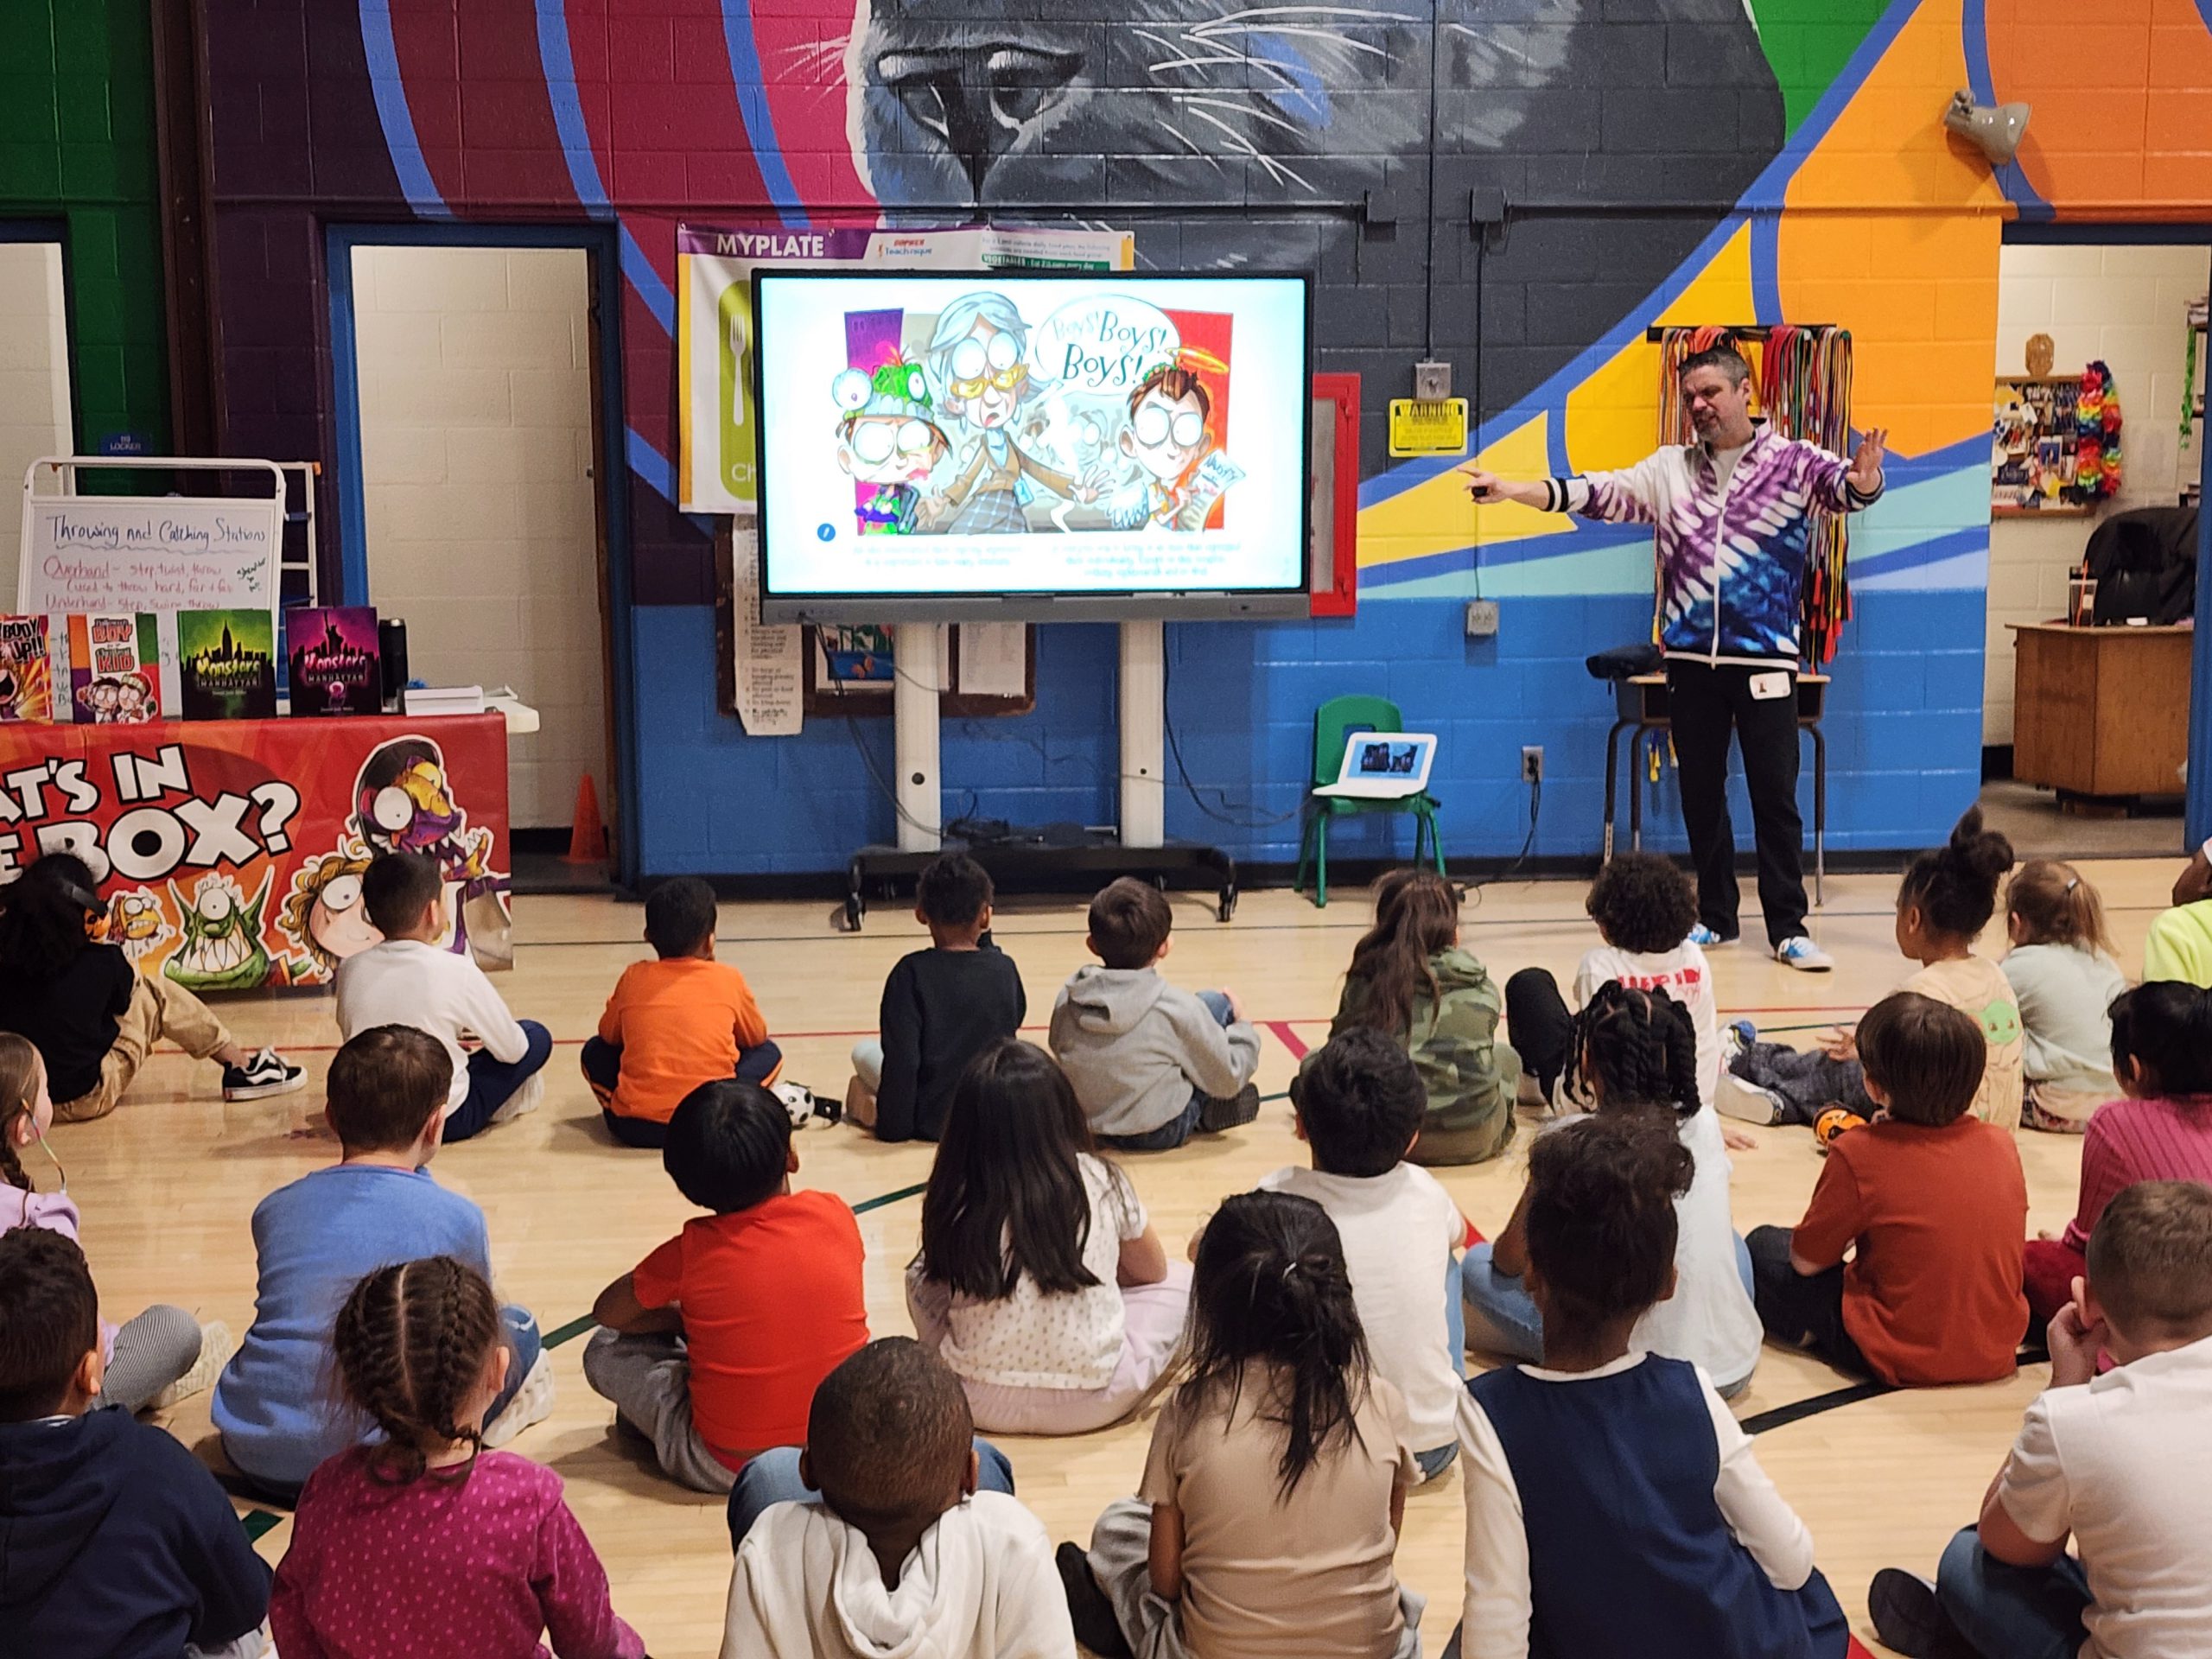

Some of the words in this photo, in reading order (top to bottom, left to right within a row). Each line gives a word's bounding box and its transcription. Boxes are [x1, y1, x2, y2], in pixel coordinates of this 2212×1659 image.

[716, 232, 824, 257] MYPLATE
[1099, 310, 1167, 355] Boys!
[1062, 343, 1143, 388] Boys!
[1400, 403, 1458, 417] WARNING
[46, 514, 119, 547] Throwing
[159, 520, 210, 550] Catching
[214, 518, 266, 543] Stations
[43, 556, 110, 578] Overhand
[92, 624, 132, 643] BOY
[97, 656, 134, 673] KID
[196, 657, 261, 677] Monsters
[304, 653, 366, 670] Monsters
[111, 743, 191, 803] IN
[35, 780, 300, 883] BOX?
